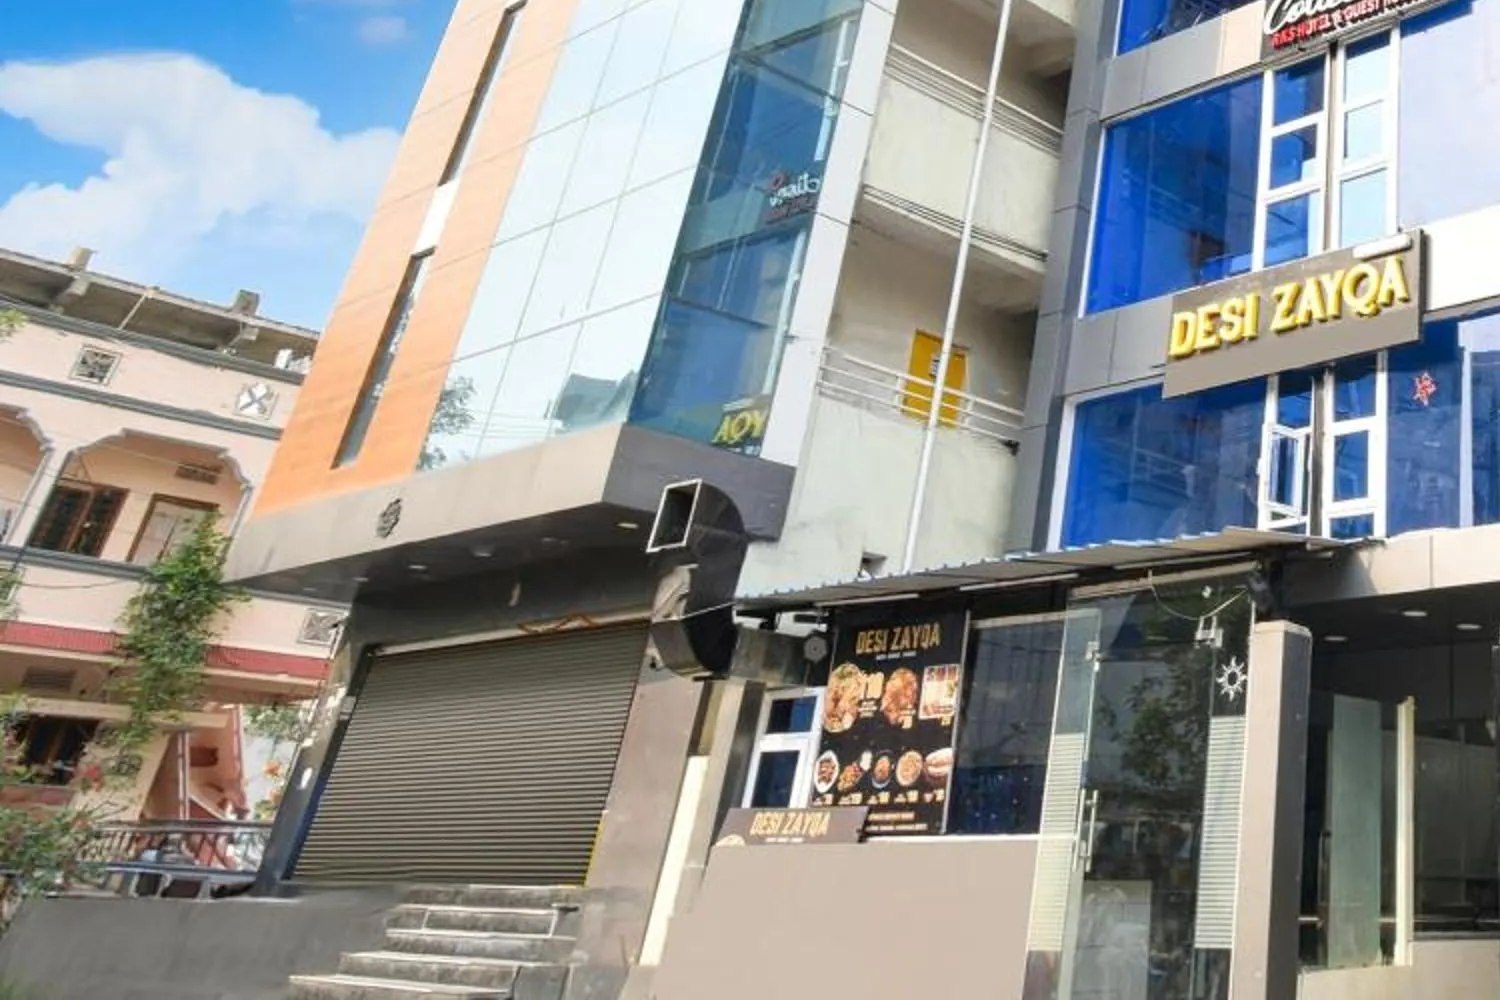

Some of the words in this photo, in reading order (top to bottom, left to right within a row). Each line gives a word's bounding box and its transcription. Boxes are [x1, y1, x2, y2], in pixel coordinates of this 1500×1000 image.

[1168, 292, 1261, 358] DESI
[1270, 254, 1411, 333] ZAYQA
[855, 627, 889, 655] DESI
[890, 621, 941, 650] ZAYQA
[750, 811, 782, 836] DESI
[781, 811, 831, 837] ZAYQA
